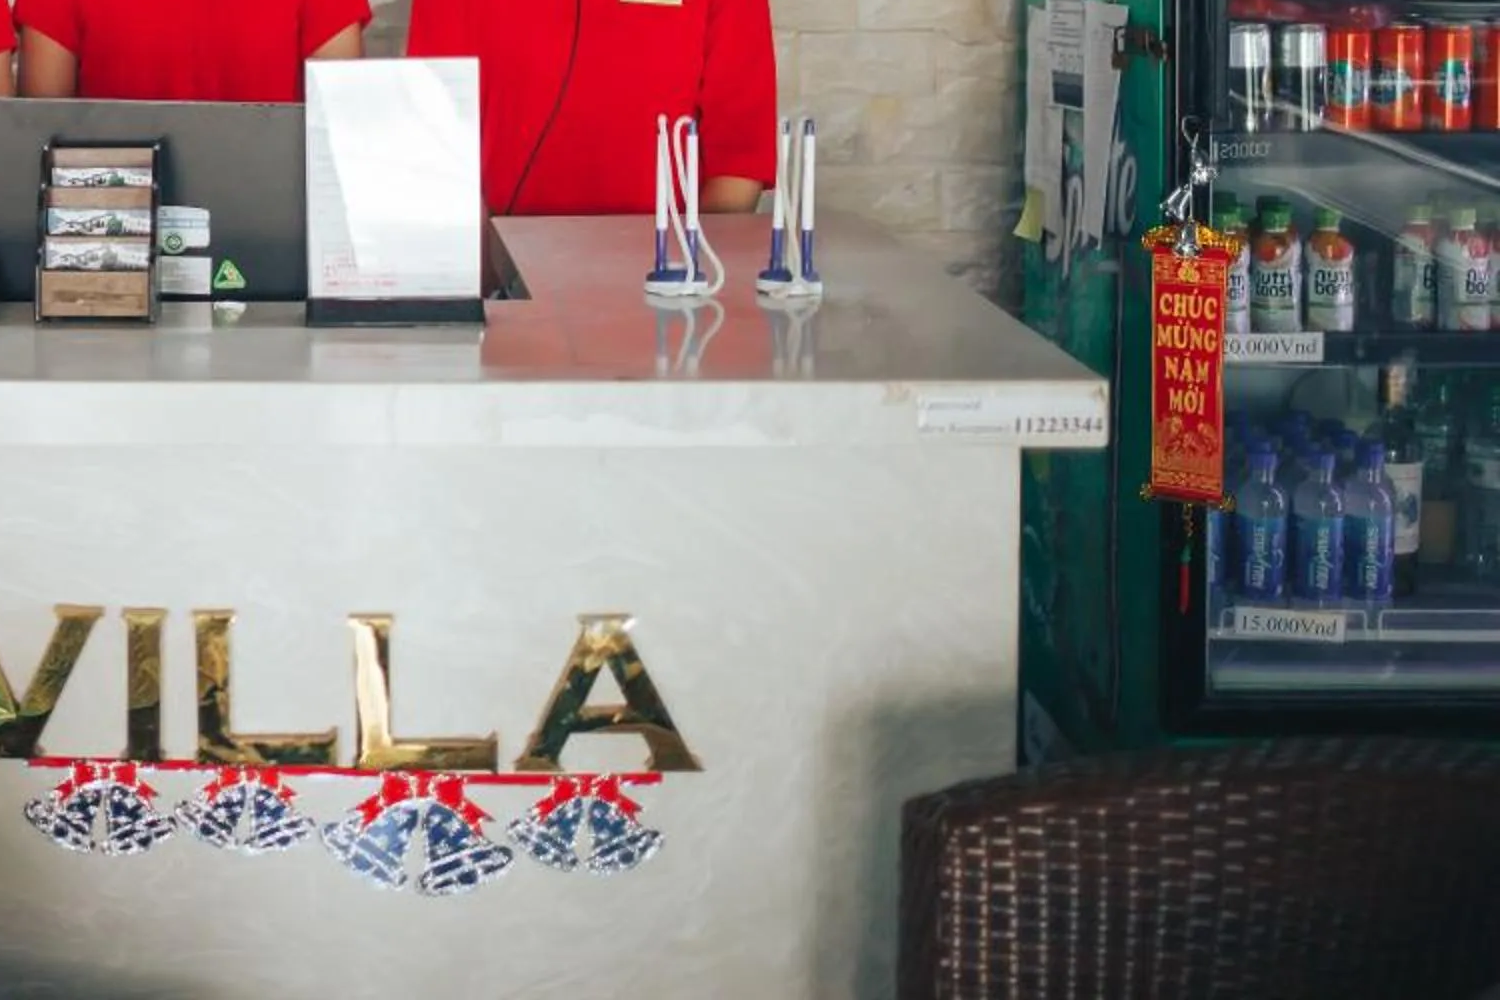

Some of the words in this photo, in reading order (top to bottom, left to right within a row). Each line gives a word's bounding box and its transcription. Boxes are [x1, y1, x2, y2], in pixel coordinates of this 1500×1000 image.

[1159, 288, 1218, 320] CHÚC
[1157, 319, 1217, 353] MỪNG
[1164, 352, 1209, 384] NĂM
[1168, 383, 1206, 416] MỚI
[1014, 416, 1104, 435] 11223344
[1242, 614, 1338, 637] 15.000Vnd
